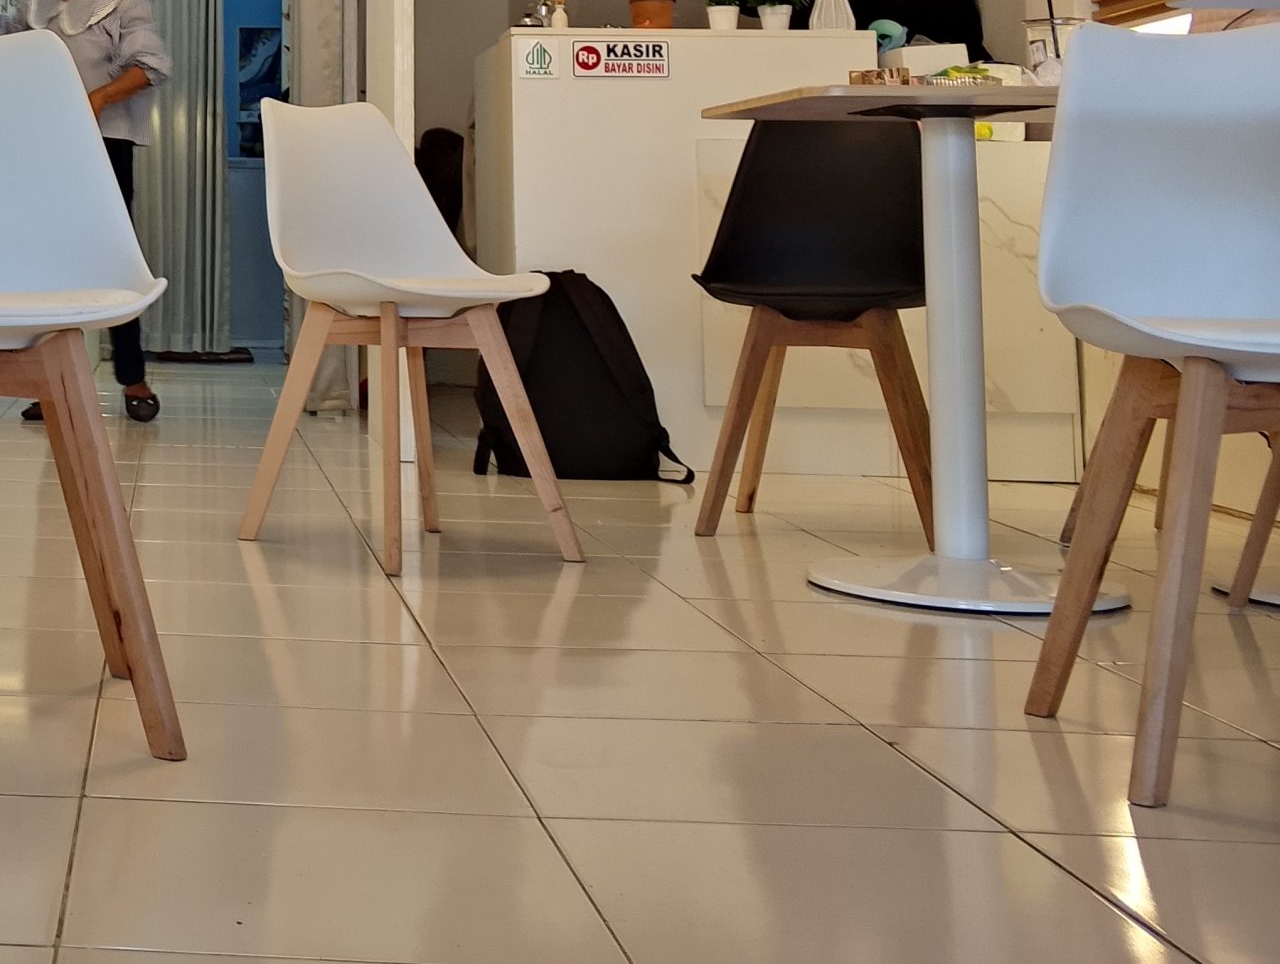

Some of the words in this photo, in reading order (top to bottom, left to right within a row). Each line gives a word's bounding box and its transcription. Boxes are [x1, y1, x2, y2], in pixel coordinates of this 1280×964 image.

[578, 50, 597, 65] Rp
[606, 44, 664, 58] KASIR
[604, 62, 634, 73] BAYAR
[636, 63, 665, 74] DISINI
